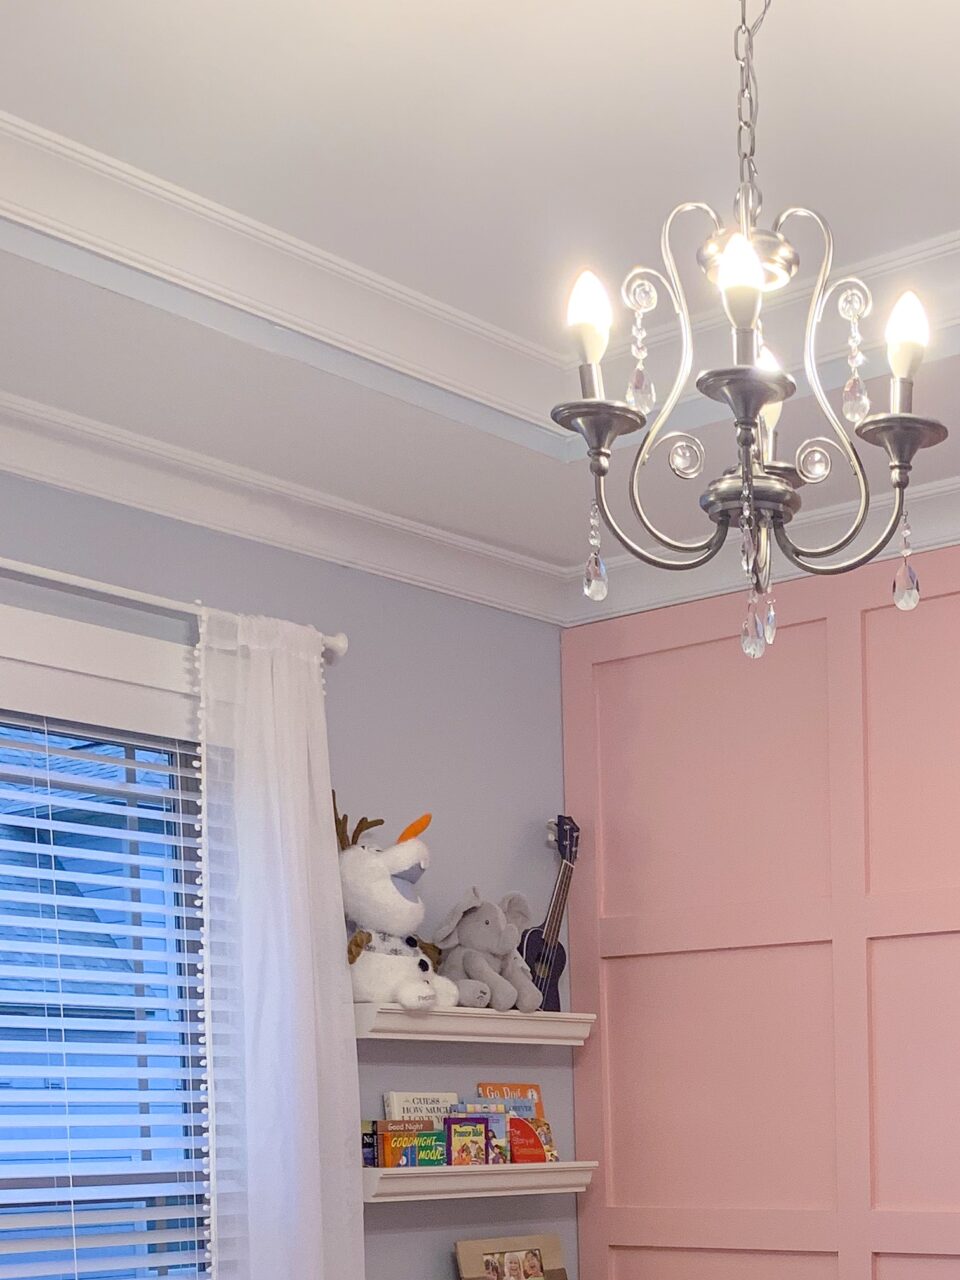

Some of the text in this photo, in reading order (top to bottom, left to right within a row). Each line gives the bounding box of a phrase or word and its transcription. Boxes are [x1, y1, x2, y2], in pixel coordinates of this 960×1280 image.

[412, 1097, 440, 1105] GUESS
[402, 1106, 452, 1114] HOW MUCH
[388, 1123, 424, 1132] Good Night
[391, 1136, 438, 1147] GOODNIGHT
[418, 1149, 443, 1160] MOON
